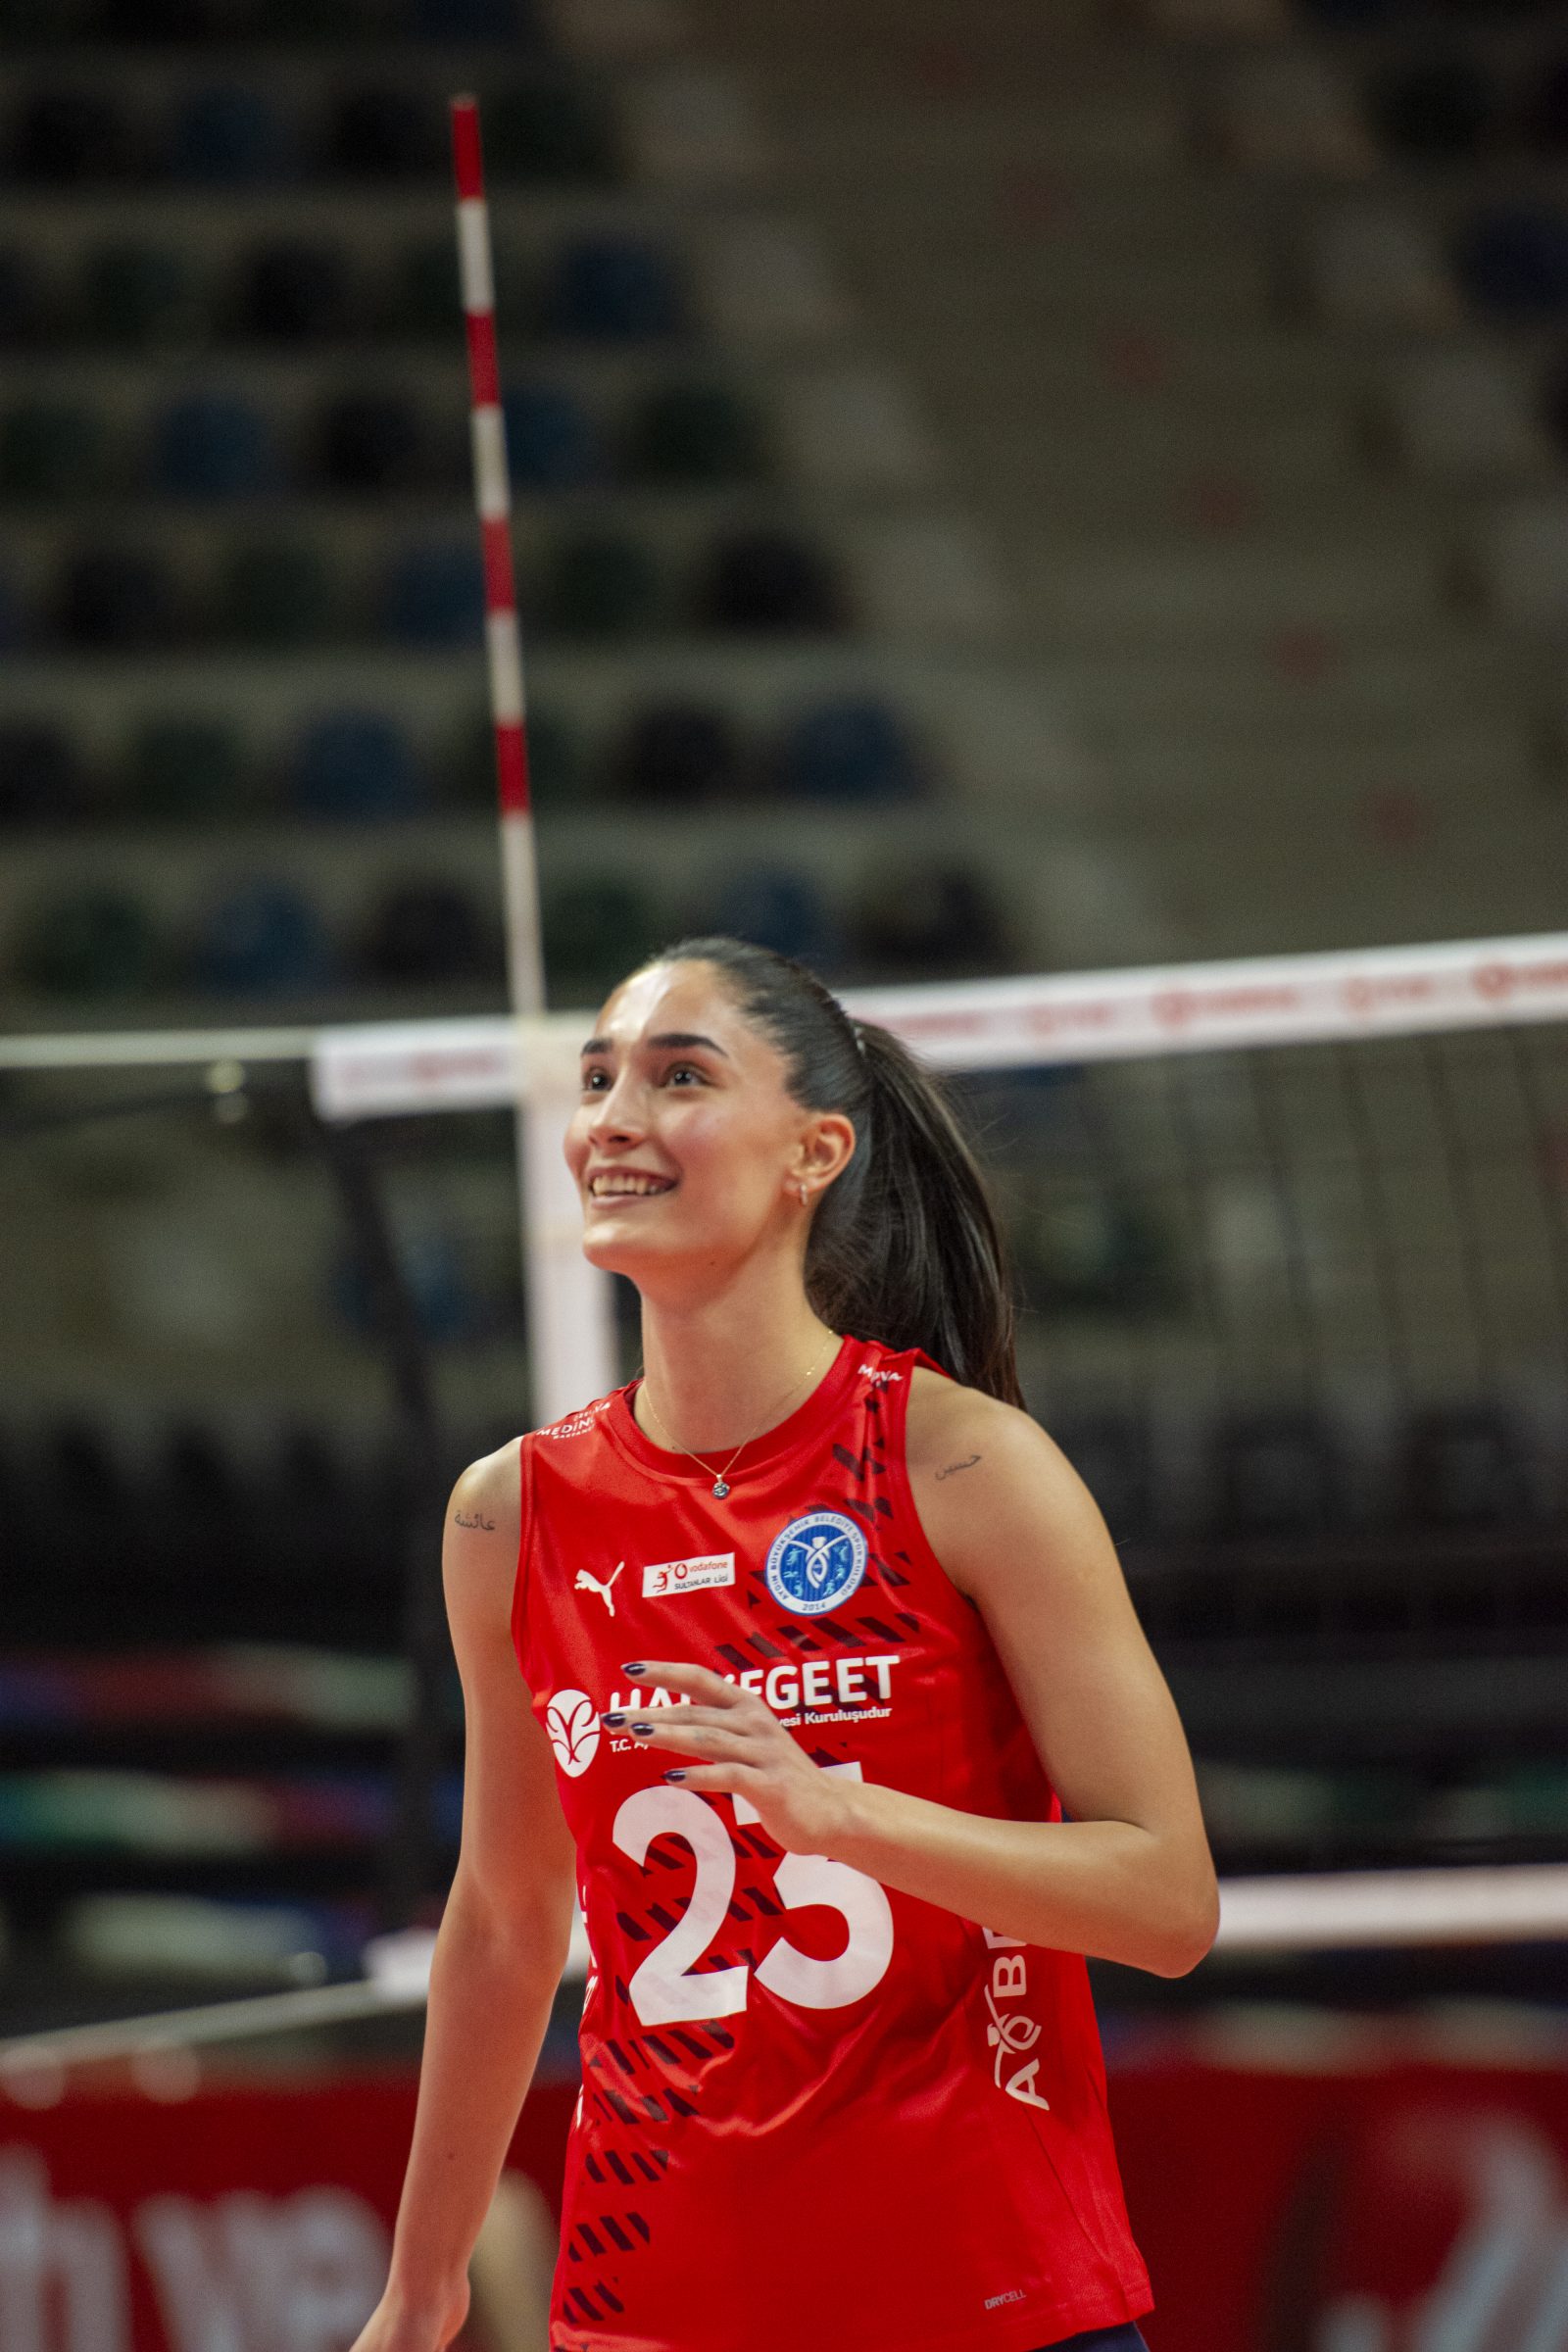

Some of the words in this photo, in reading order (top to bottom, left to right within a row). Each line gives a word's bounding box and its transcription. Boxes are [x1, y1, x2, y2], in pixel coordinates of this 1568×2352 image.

[689, 1560, 728, 1573] vodafone
[674, 1577, 711, 1591] SULTANLAR
[805, 1706, 893, 1725] Kuruluşudur
[612, 1761, 894, 2027] 23
[984, 2288, 1027, 2311] DRYCELL
